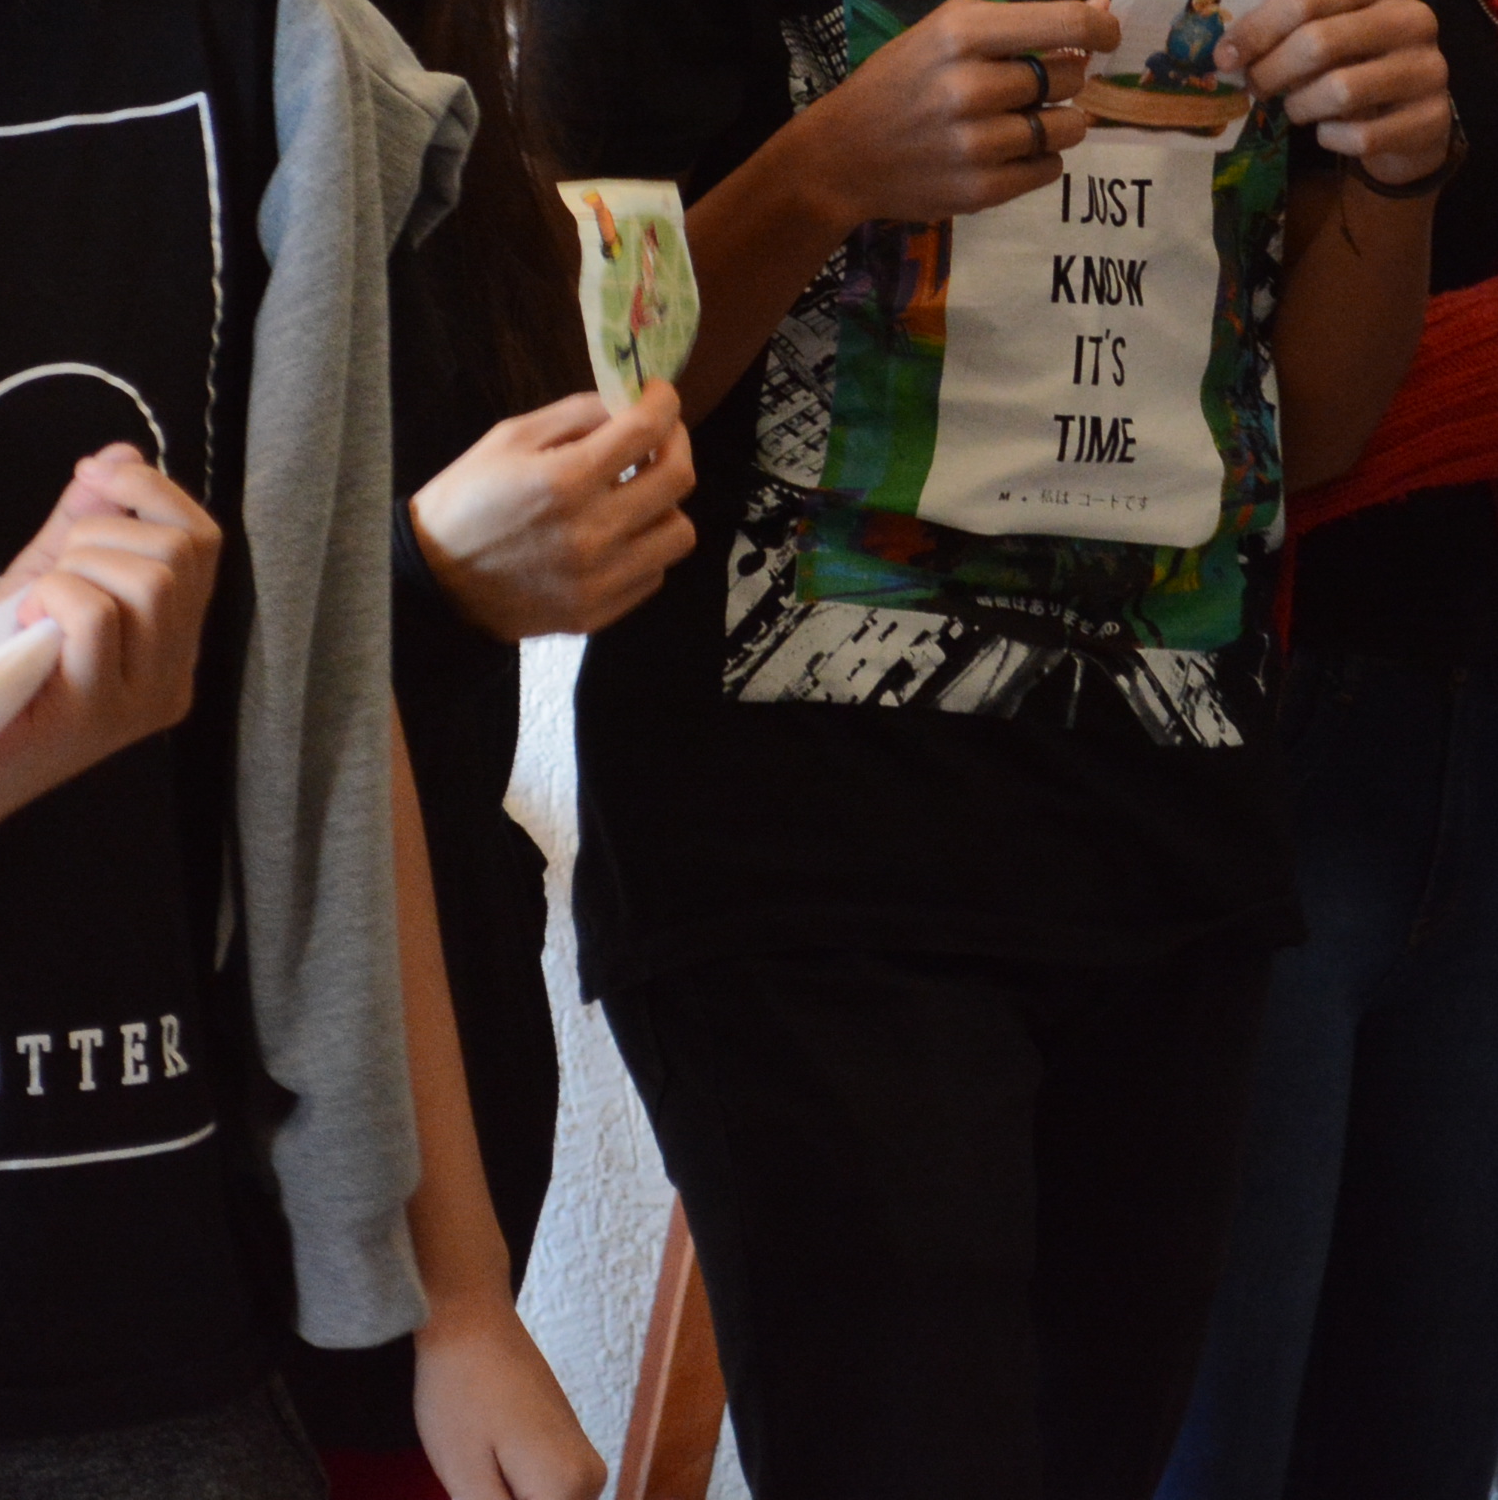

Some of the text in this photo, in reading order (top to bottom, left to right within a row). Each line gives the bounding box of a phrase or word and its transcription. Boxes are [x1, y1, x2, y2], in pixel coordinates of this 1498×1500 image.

[1080, 175, 1153, 228] JUST
[1051, 255, 1148, 307] KNOW
[1072, 329, 1127, 387] IT'S
[1053, 414, 1137, 464] TIME
